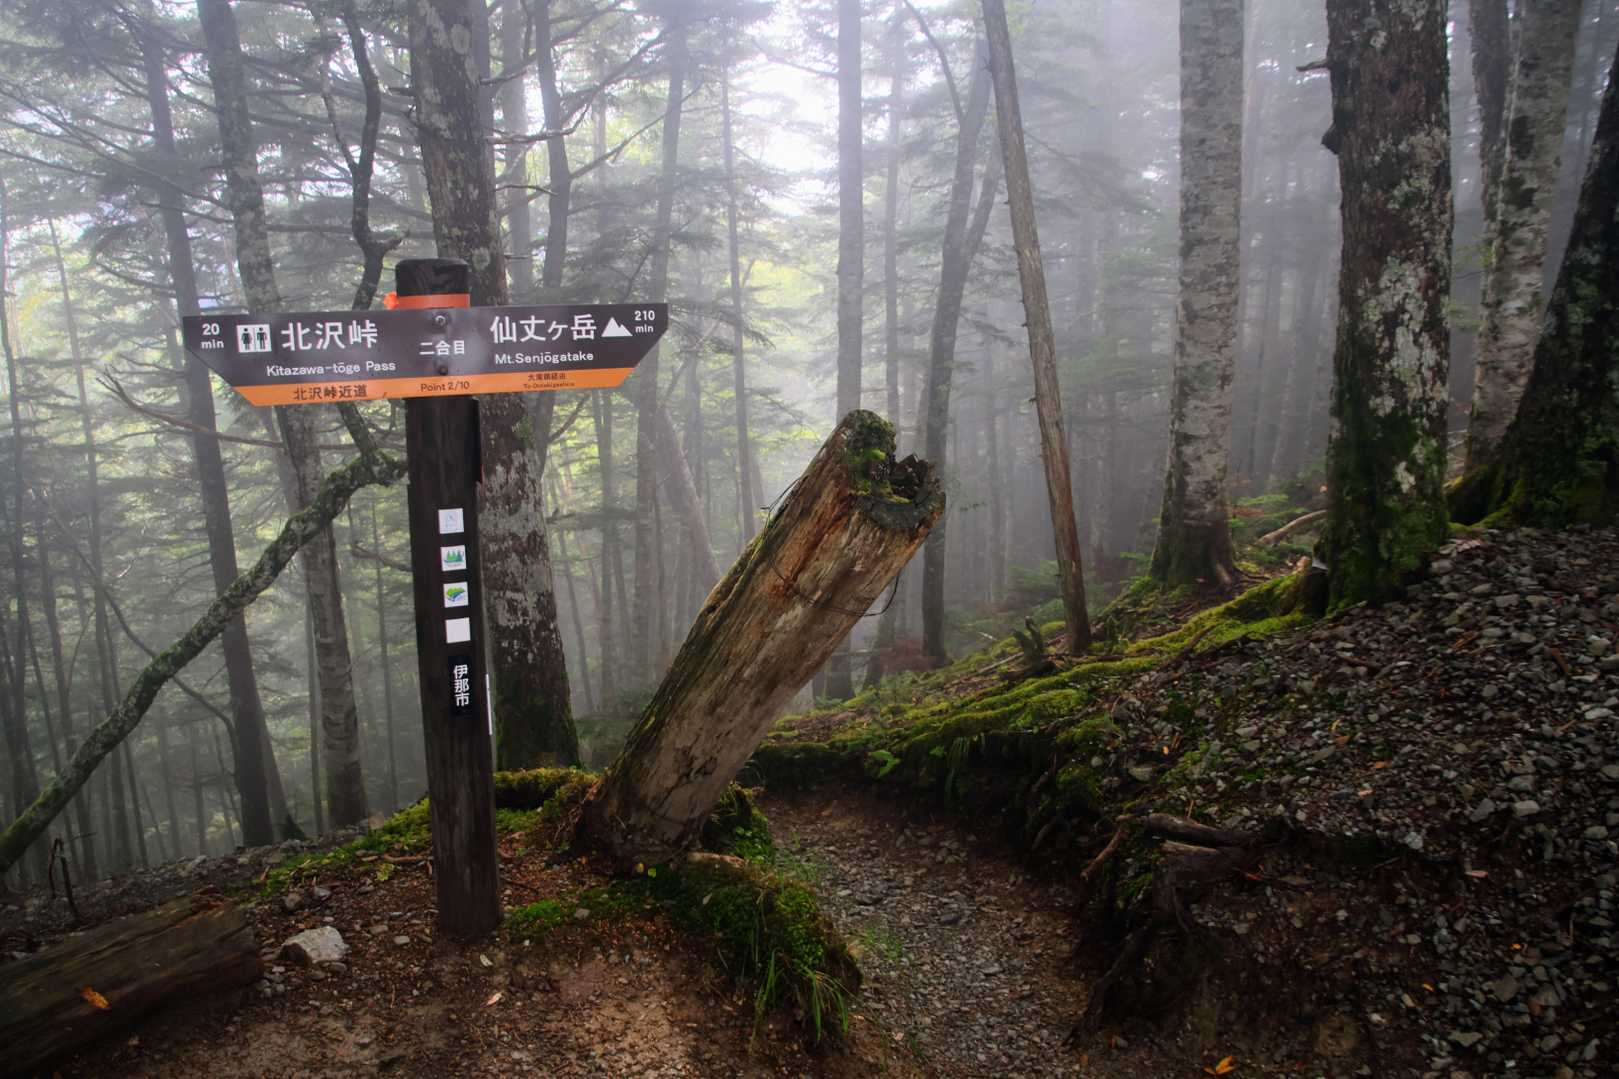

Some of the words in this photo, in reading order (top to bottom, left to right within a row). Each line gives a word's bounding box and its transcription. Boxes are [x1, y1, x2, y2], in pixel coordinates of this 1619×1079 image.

[634, 310, 656, 322] 210
[202, 323, 220, 336] 20
[280, 319, 378, 351] 北沢峠
[635, 324, 654, 333] min
[201, 338, 224, 349] min
[419, 340, 465, 356] 二合目
[266, 361, 361, 377] Kitazawa-tōge
[366, 360, 397, 371] Pass
[293, 384, 368, 400] 北沢峠近道
[420, 383, 446, 392] Point
[447, 380, 470, 391] 2/10
[453, 664, 470, 707] 伊那市
